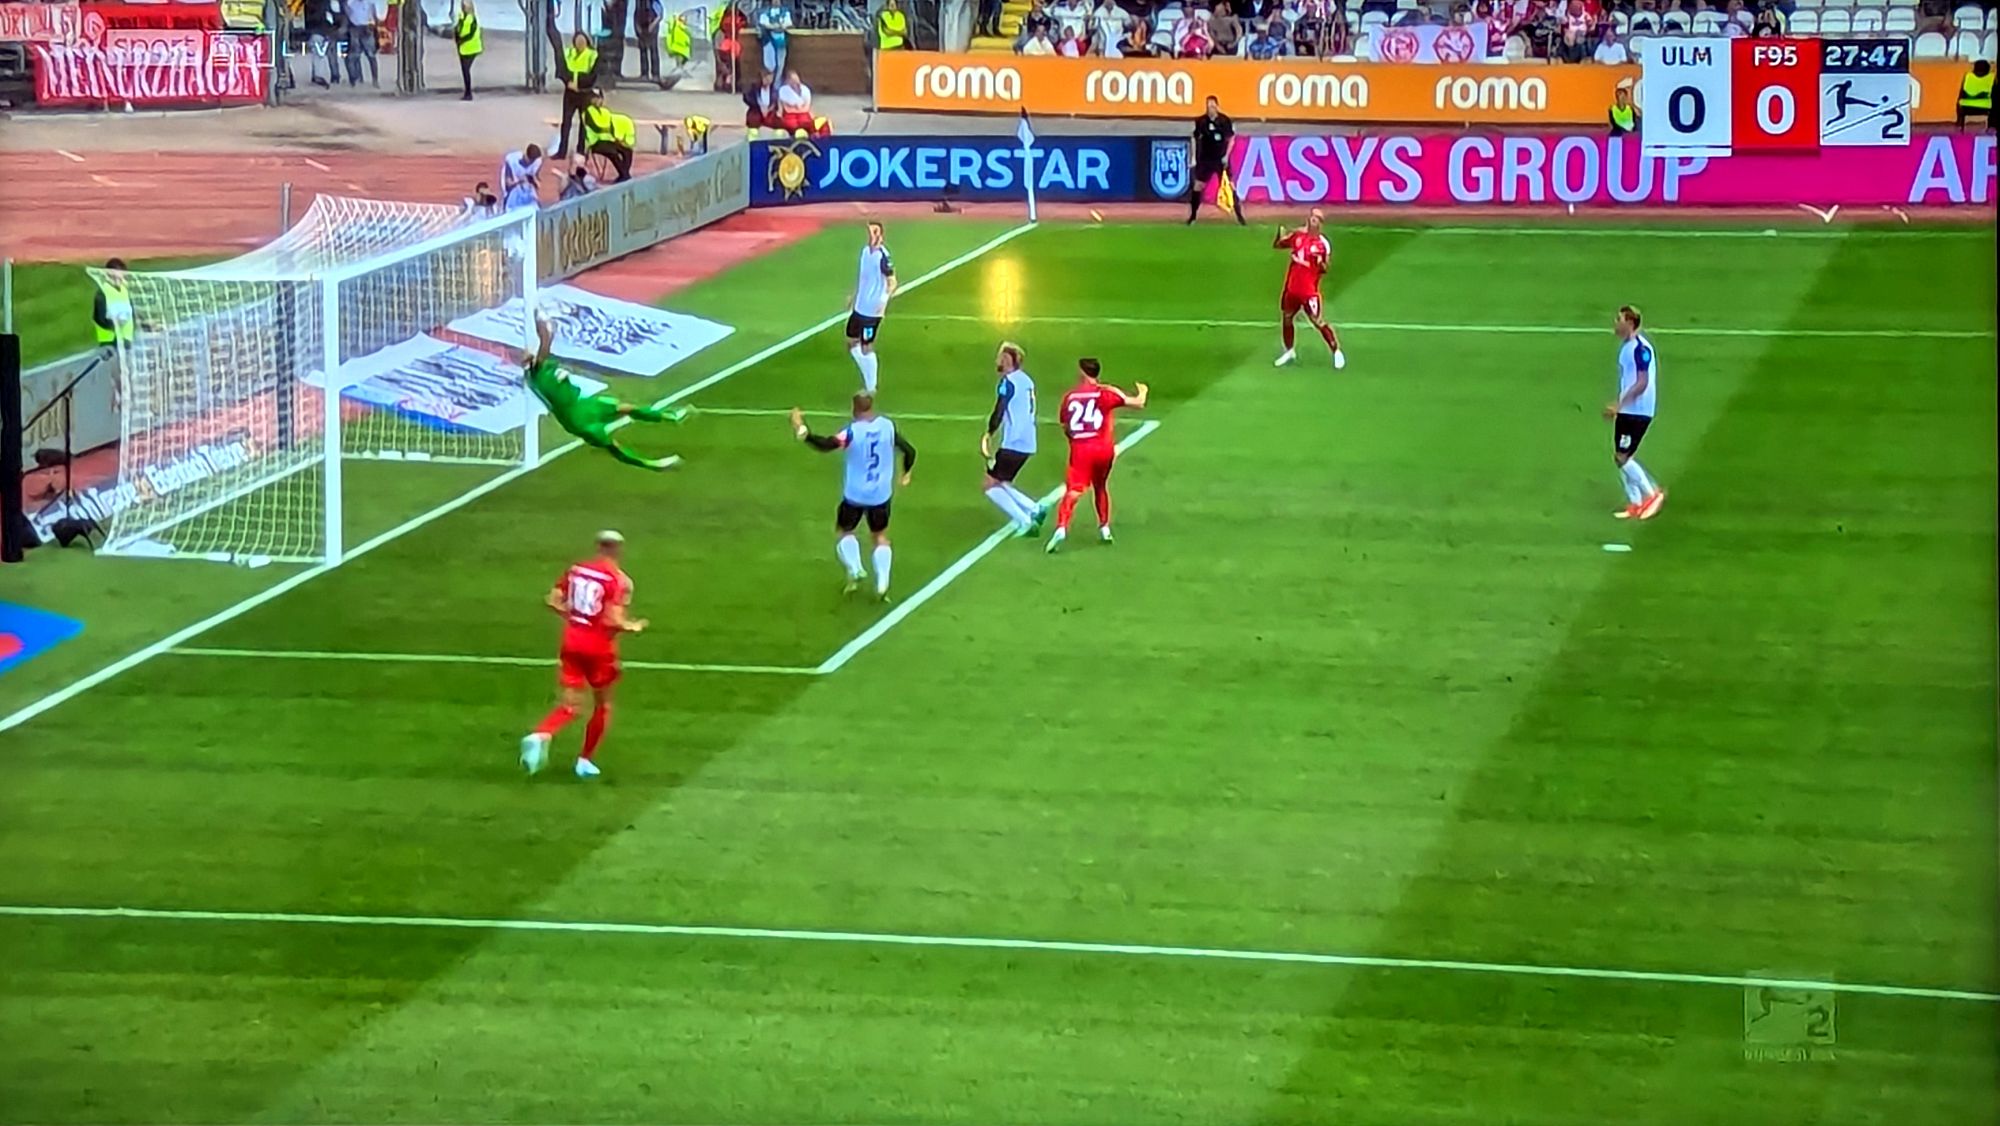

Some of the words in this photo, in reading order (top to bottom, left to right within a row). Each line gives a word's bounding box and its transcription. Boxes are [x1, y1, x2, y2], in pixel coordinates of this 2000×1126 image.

[914, 65, 1021, 99] roma
[1085, 71, 1193, 104] roma
[1258, 73, 1368, 107] roma
[1434, 76, 1547, 110] roma
[819, 147, 1111, 190] JOKERSTAR
[1235, 136, 1423, 201] ASYS
[1448, 136, 1710, 202] GROUP
[1068, 399, 1103, 431] 24
[869, 440, 880, 470] 5
